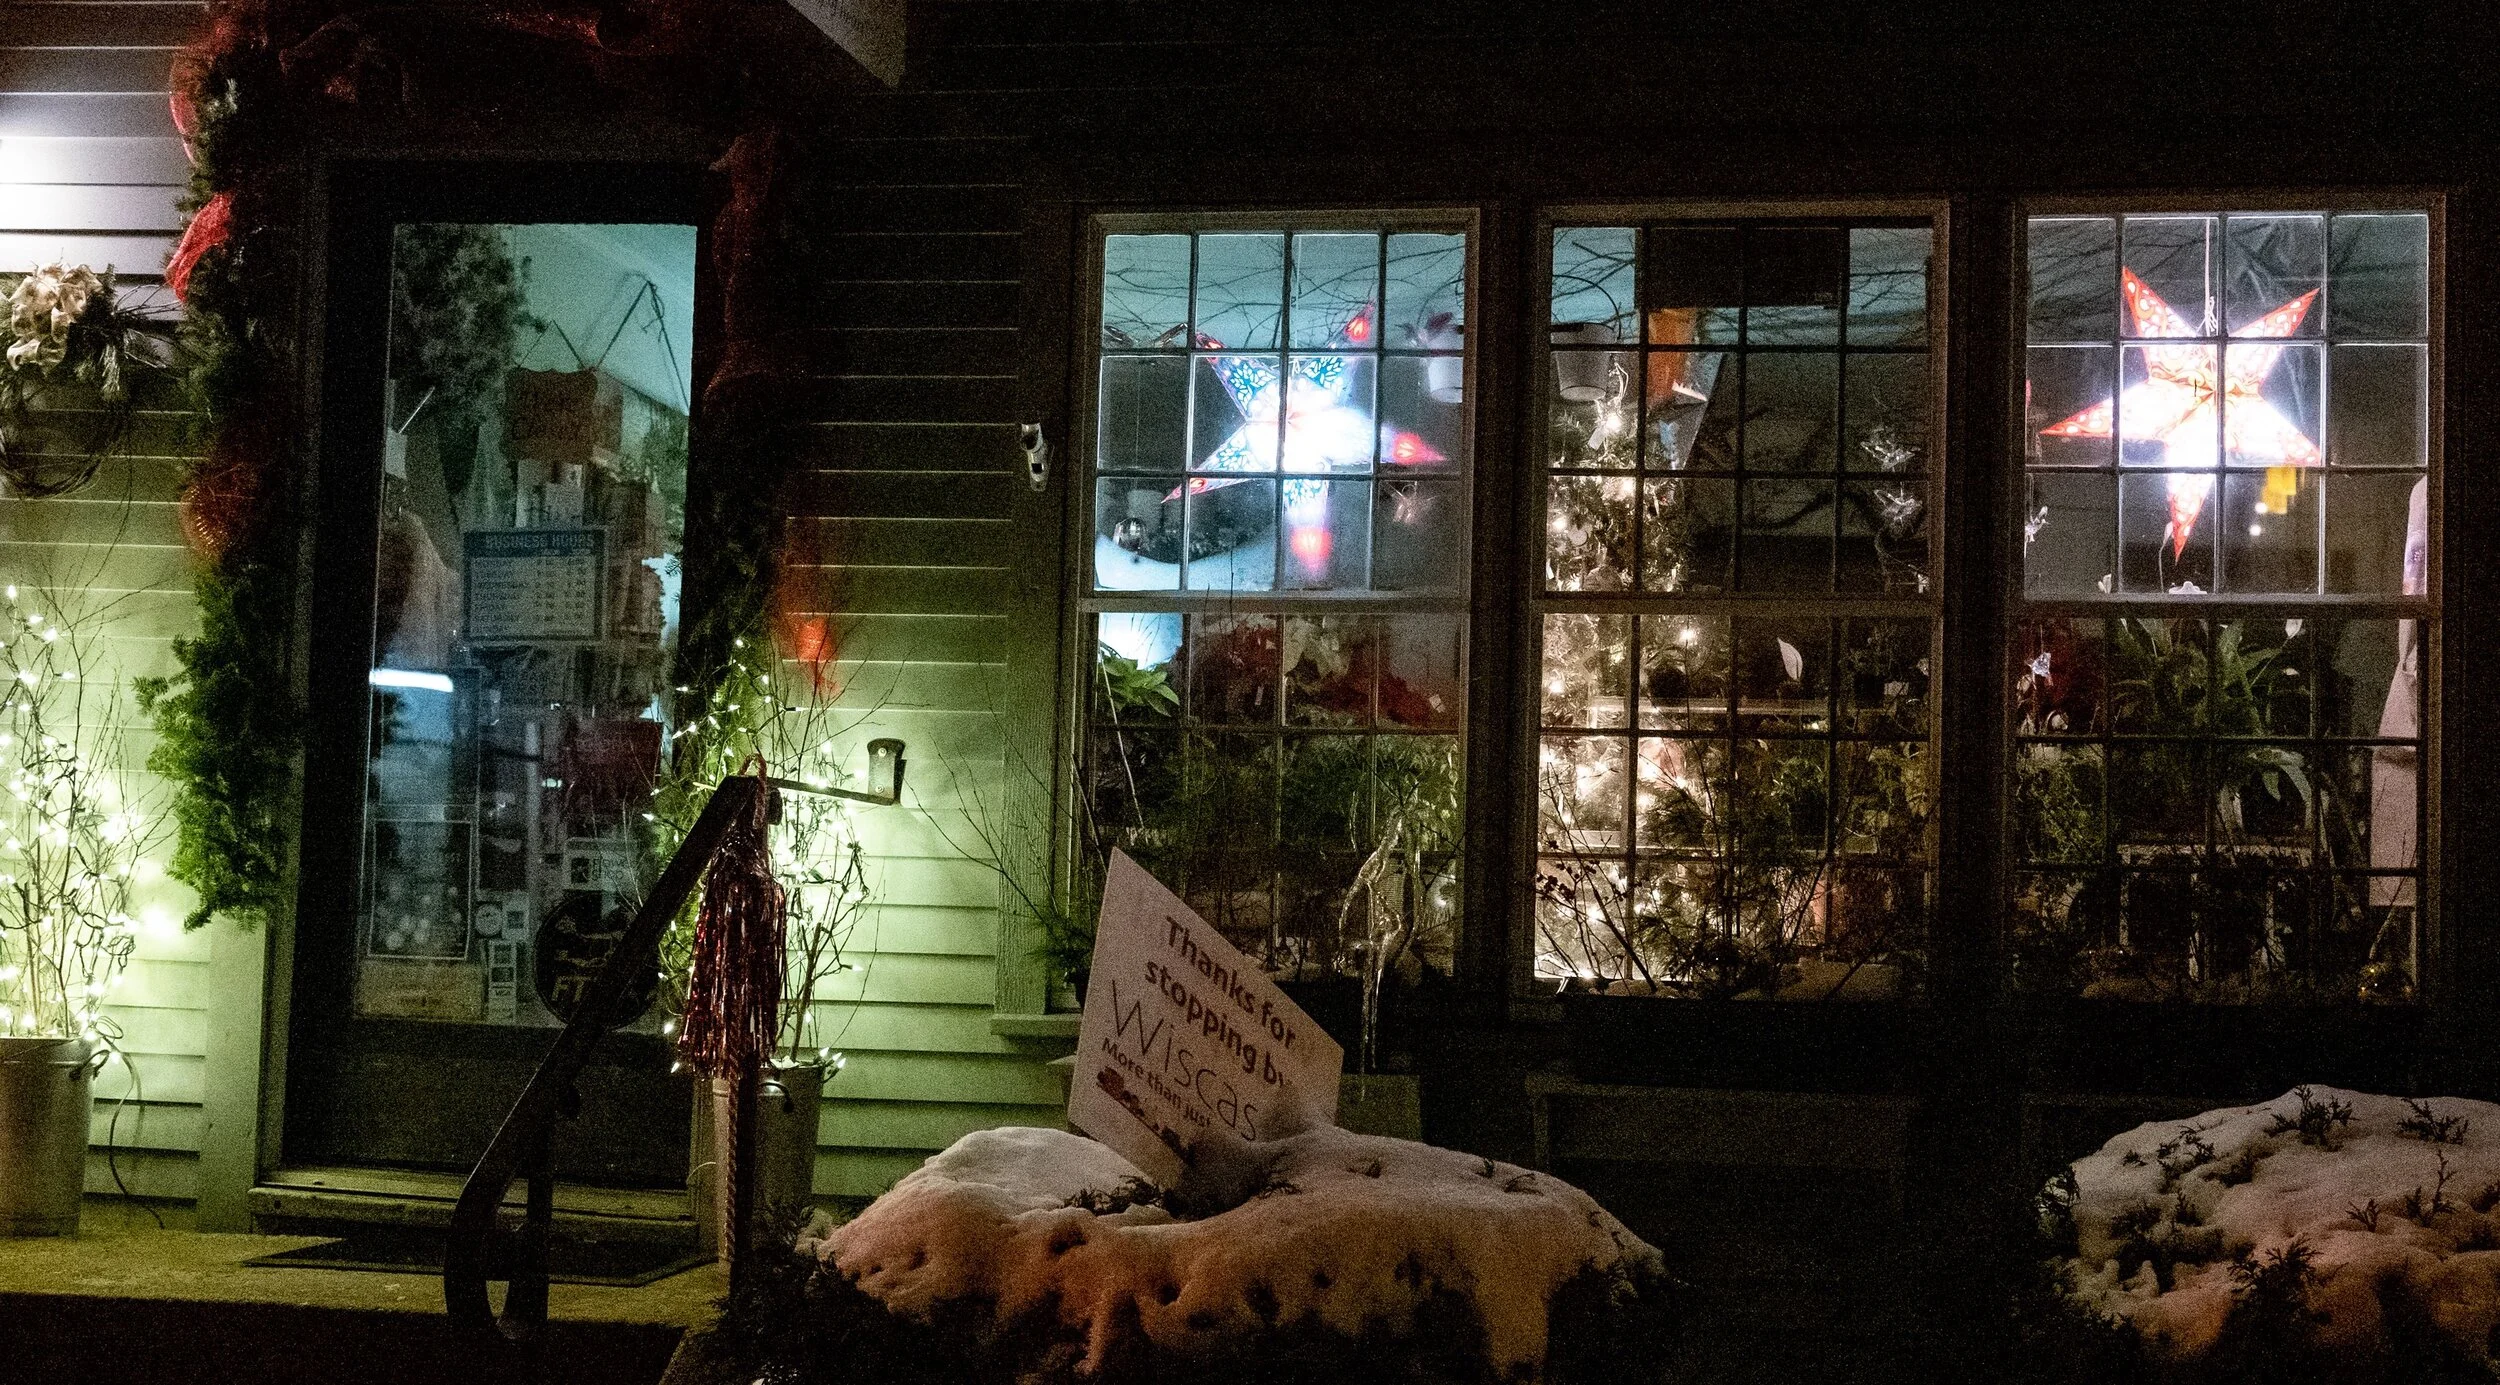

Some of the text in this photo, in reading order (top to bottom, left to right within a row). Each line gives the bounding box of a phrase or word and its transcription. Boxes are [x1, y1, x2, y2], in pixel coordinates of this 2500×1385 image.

[551, 975, 597, 1003] FT
[1145, 960, 1257, 1073] stopping
[1166, 916, 1296, 1048] Thanks for
[1102, 1037, 1144, 1078] More
[1146, 1071, 1183, 1109] than
